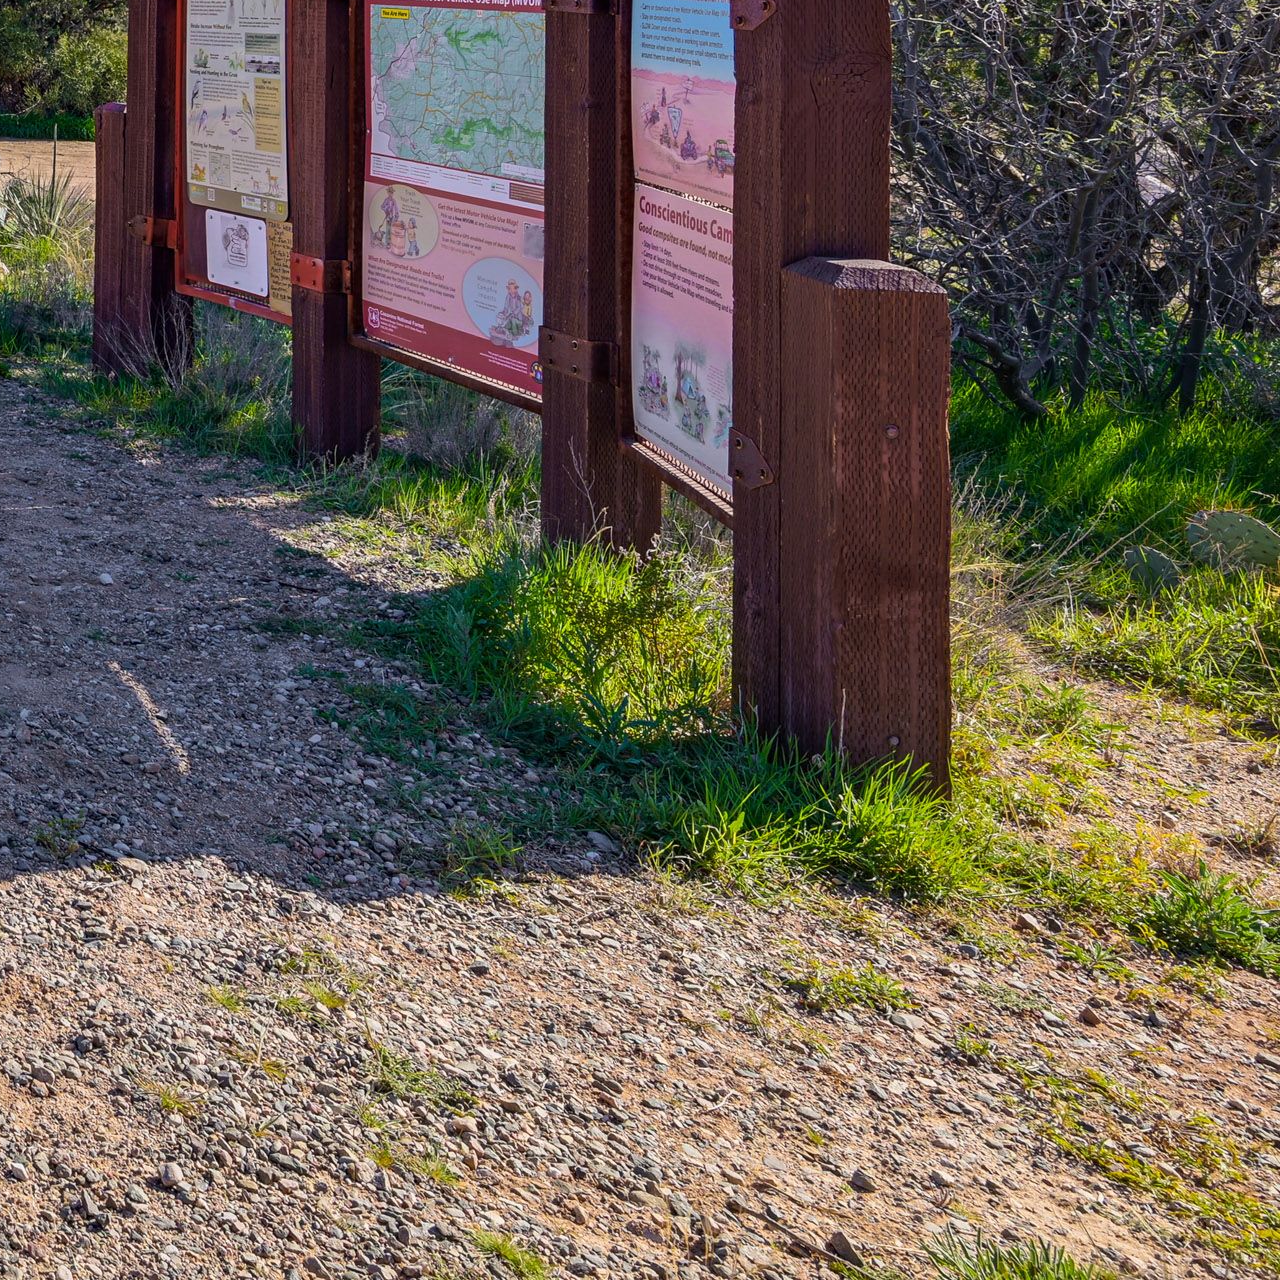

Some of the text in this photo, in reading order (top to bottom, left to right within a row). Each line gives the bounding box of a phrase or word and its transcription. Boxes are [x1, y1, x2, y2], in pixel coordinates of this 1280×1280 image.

[640, 196, 708, 235] Conscientious
[639, 222, 653, 235] Good
[653, 228, 679, 246] campsites
[680, 238, 688, 249] are
[689, 240, 707, 258] found,
[708, 249, 718, 260] not
